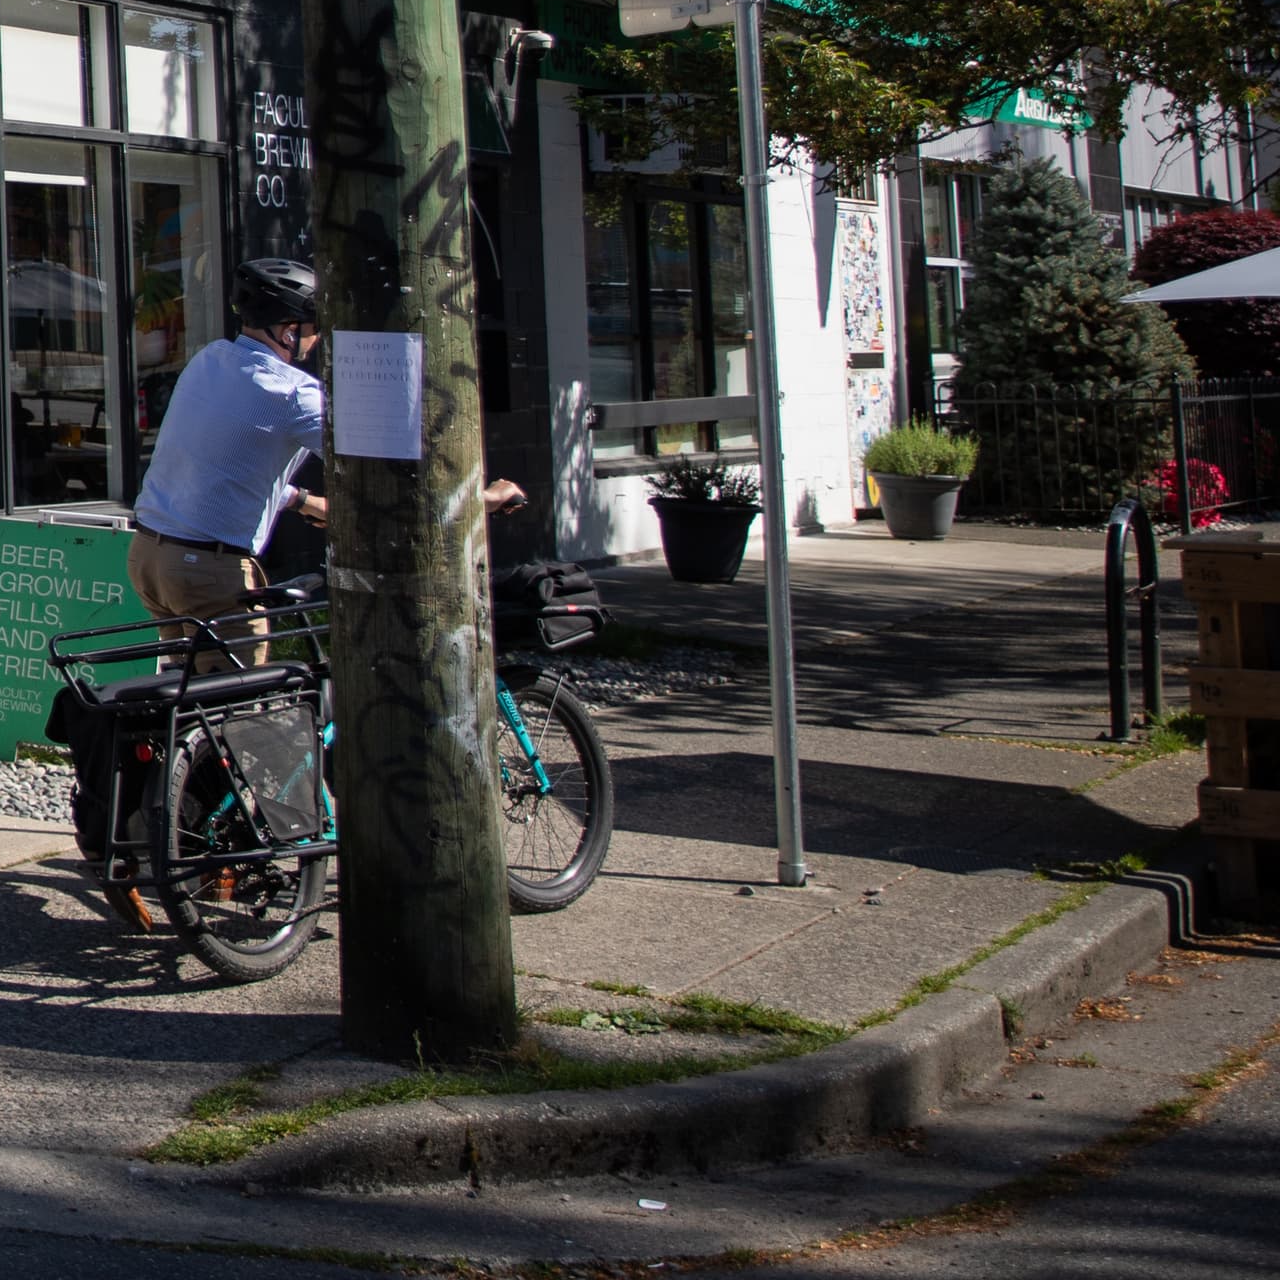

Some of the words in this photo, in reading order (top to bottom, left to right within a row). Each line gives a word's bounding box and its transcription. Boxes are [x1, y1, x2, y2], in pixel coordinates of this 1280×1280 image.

[256, 173, 288, 208] CO.
[354, 342, 390, 352] SHOP
[340, 371, 410, 383] CLOTHING
[1, 543, 69, 573] BEER,
